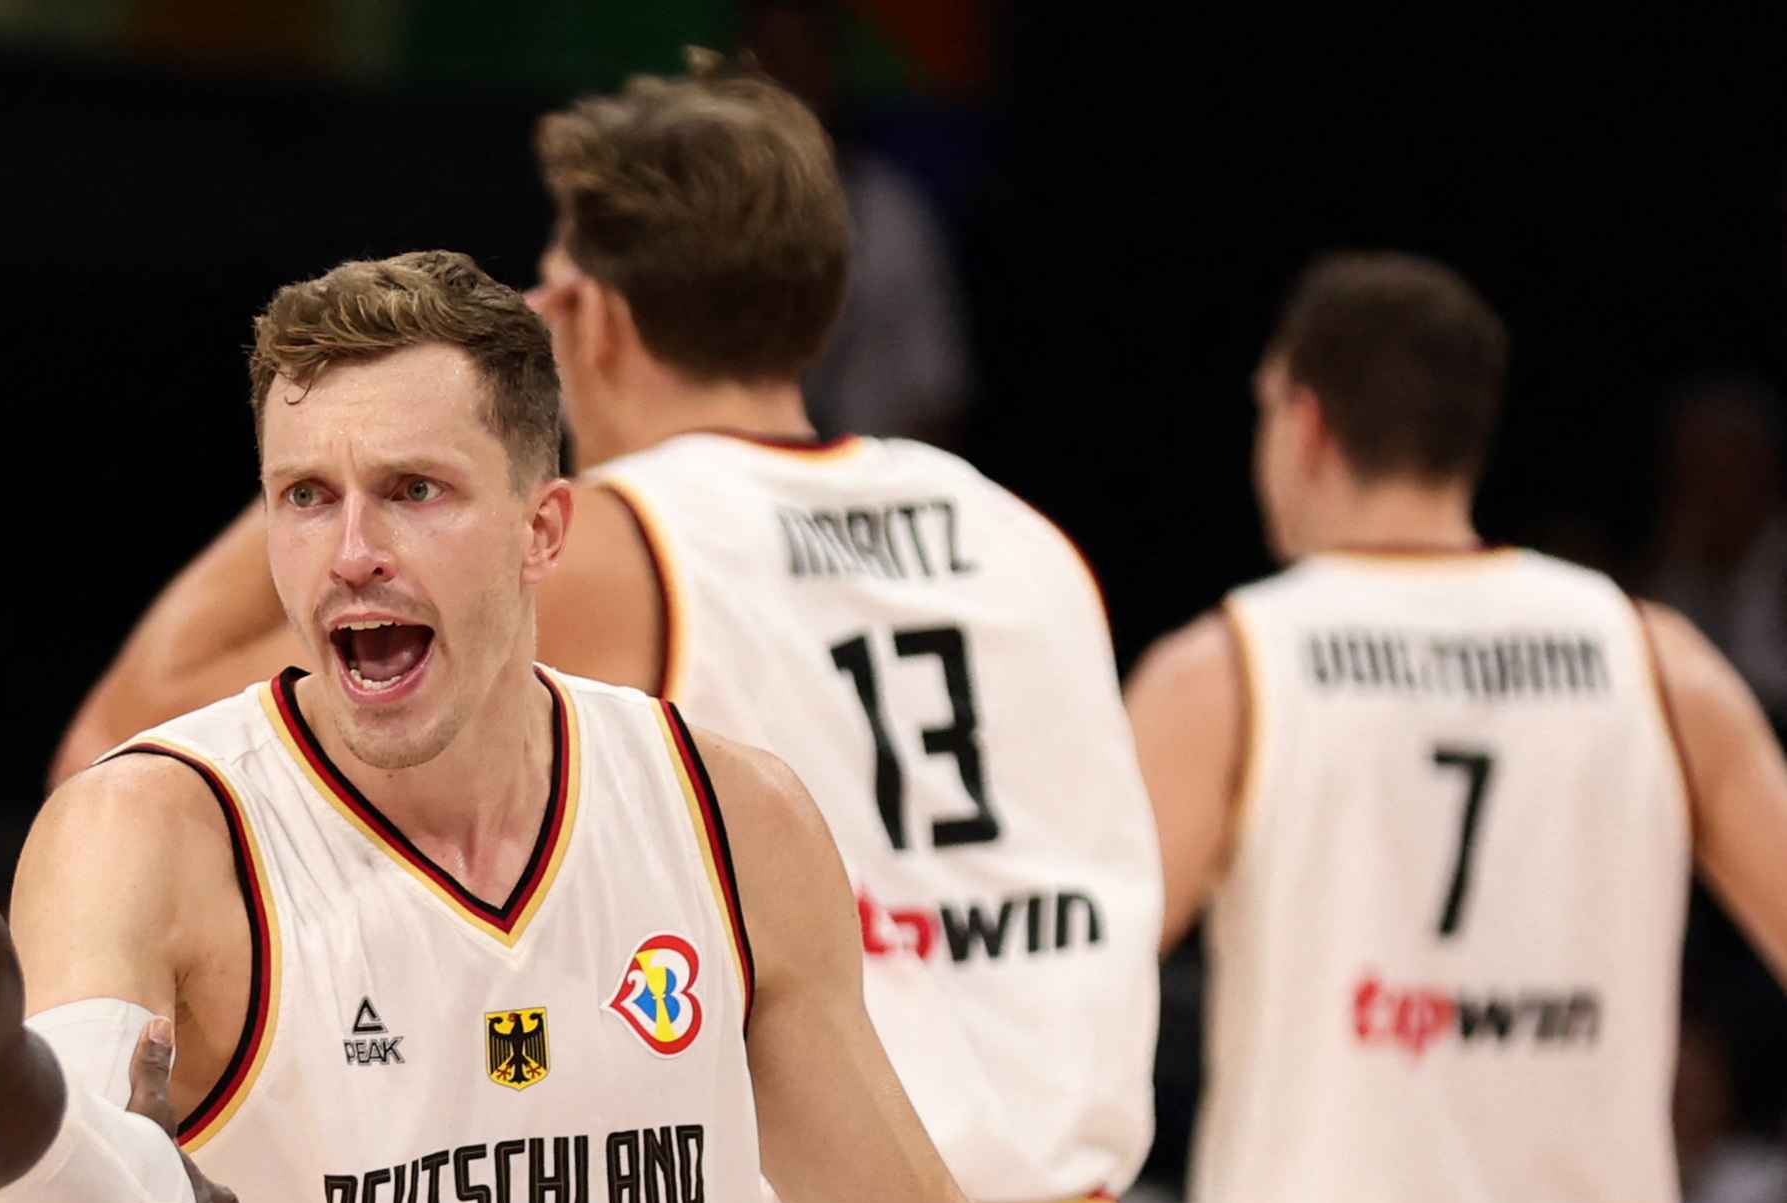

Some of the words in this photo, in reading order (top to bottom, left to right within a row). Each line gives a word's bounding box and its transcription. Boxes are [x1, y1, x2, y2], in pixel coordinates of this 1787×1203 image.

[829, 626, 1001, 851] 13
[1432, 746, 1493, 939] 7
[343, 1035, 405, 1067] PEAK
